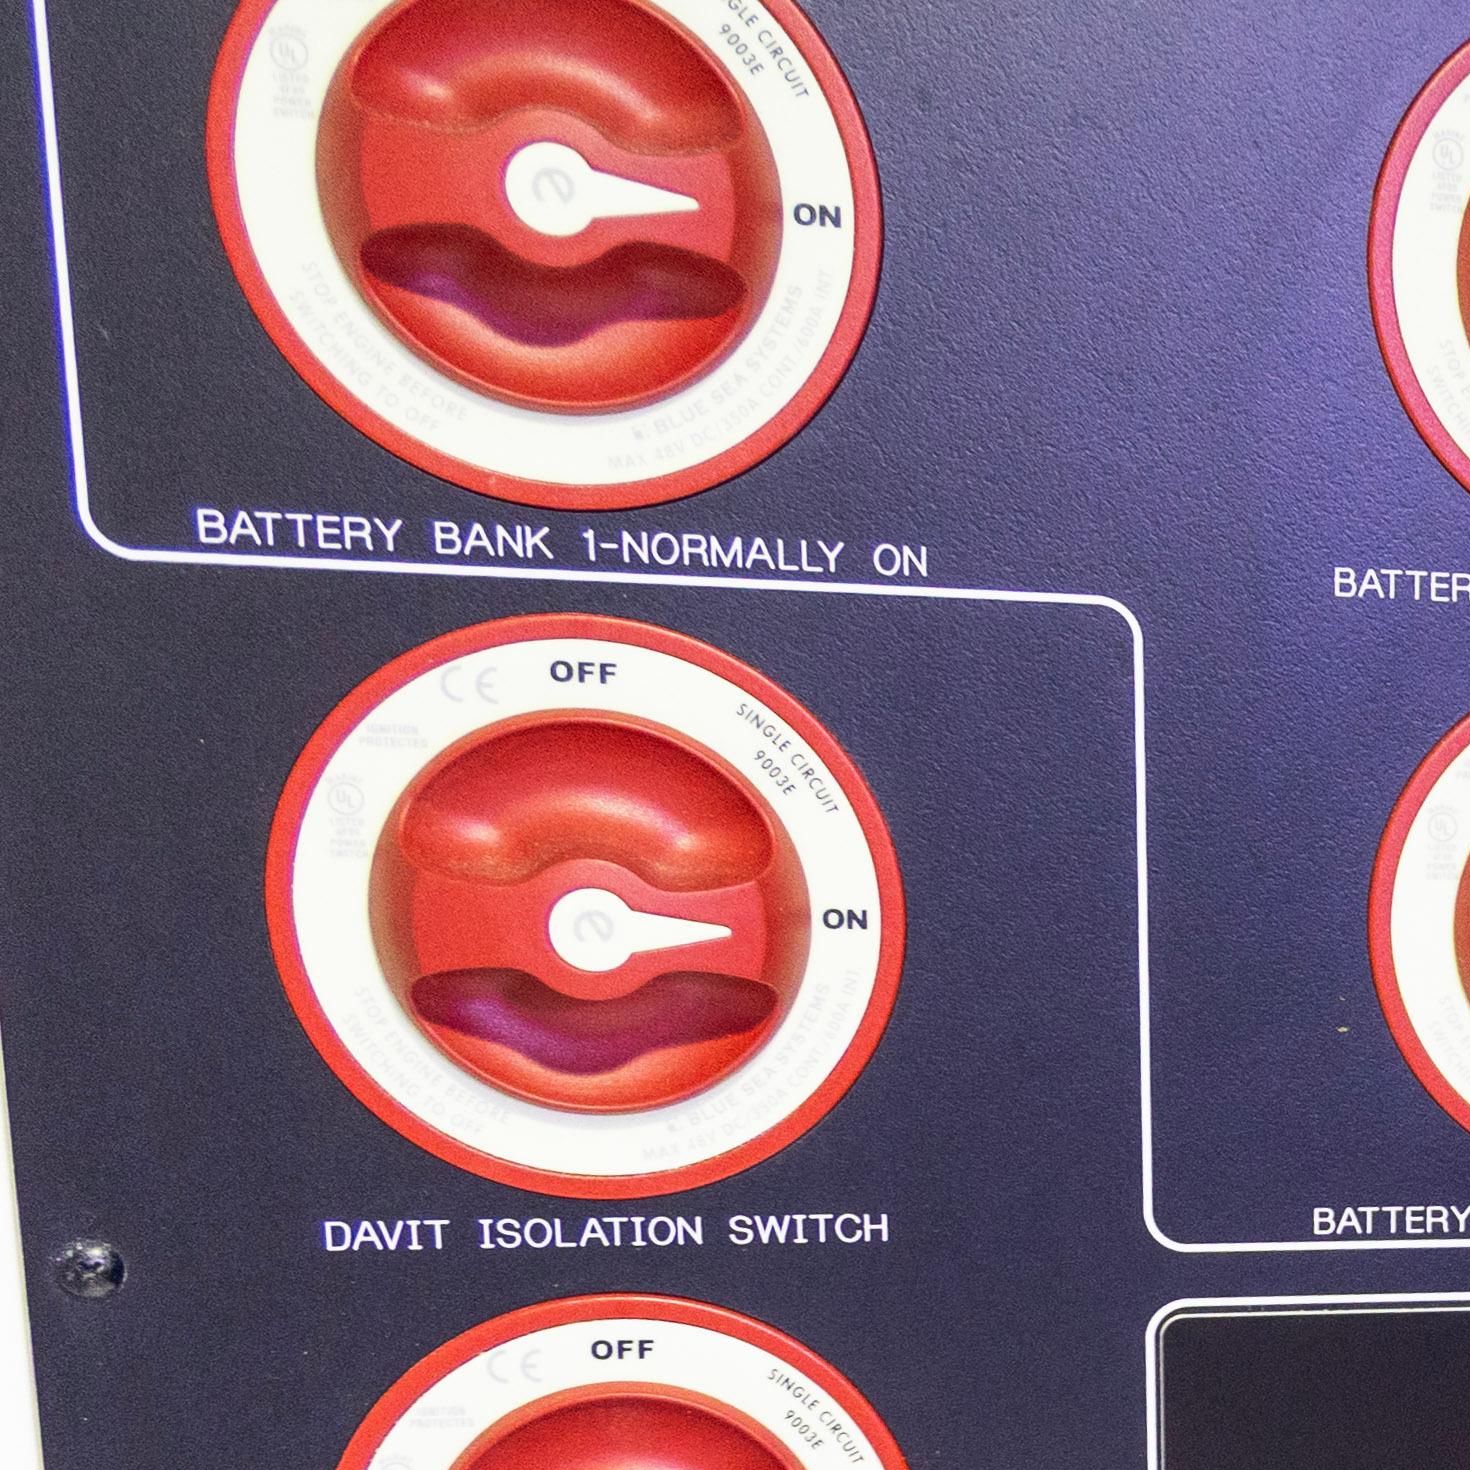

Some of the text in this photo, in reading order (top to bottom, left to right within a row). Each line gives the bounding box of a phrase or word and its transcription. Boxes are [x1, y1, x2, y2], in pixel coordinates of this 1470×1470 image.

[718, 23, 765, 76] 9003E
[757, 29, 810, 97] CIRCUIT
[792, 201, 843, 230] ON
[289, 289, 441, 431] SWITCHING TO OFF
[301, 260, 469, 422] STOP ENGINE BEFORE
[652, 283, 804, 437] BLUE SEA SYSTEMS
[1438, 338, 1467, 380] STOP
[607, 452, 650, 470] MAX
[196, 507, 928, 578] BATTERY BANK 1-NORMALLY ON
[548, 658, 618, 686] OFF
[736, 701, 841, 816] SINGLE CIRCUIT
[753, 748, 797, 797] 9003E
[821, 907, 869, 932] ON
[342, 1012, 421, 1097] SWITCHING
[384, 1030, 442, 1088] ENGINE
[444, 1083, 511, 1126] BEFORE
[687, 981, 832, 1127] BLUE SEA SYSTEMS
[323, 1212, 889, 1252] DAVIT ISOLATION SWITCH
[589, 1338, 656, 1362] OFF
[767, 1367, 866, 1465] SINGLE CIRCUIT
[784, 1408, 824, 1452] 9003E
